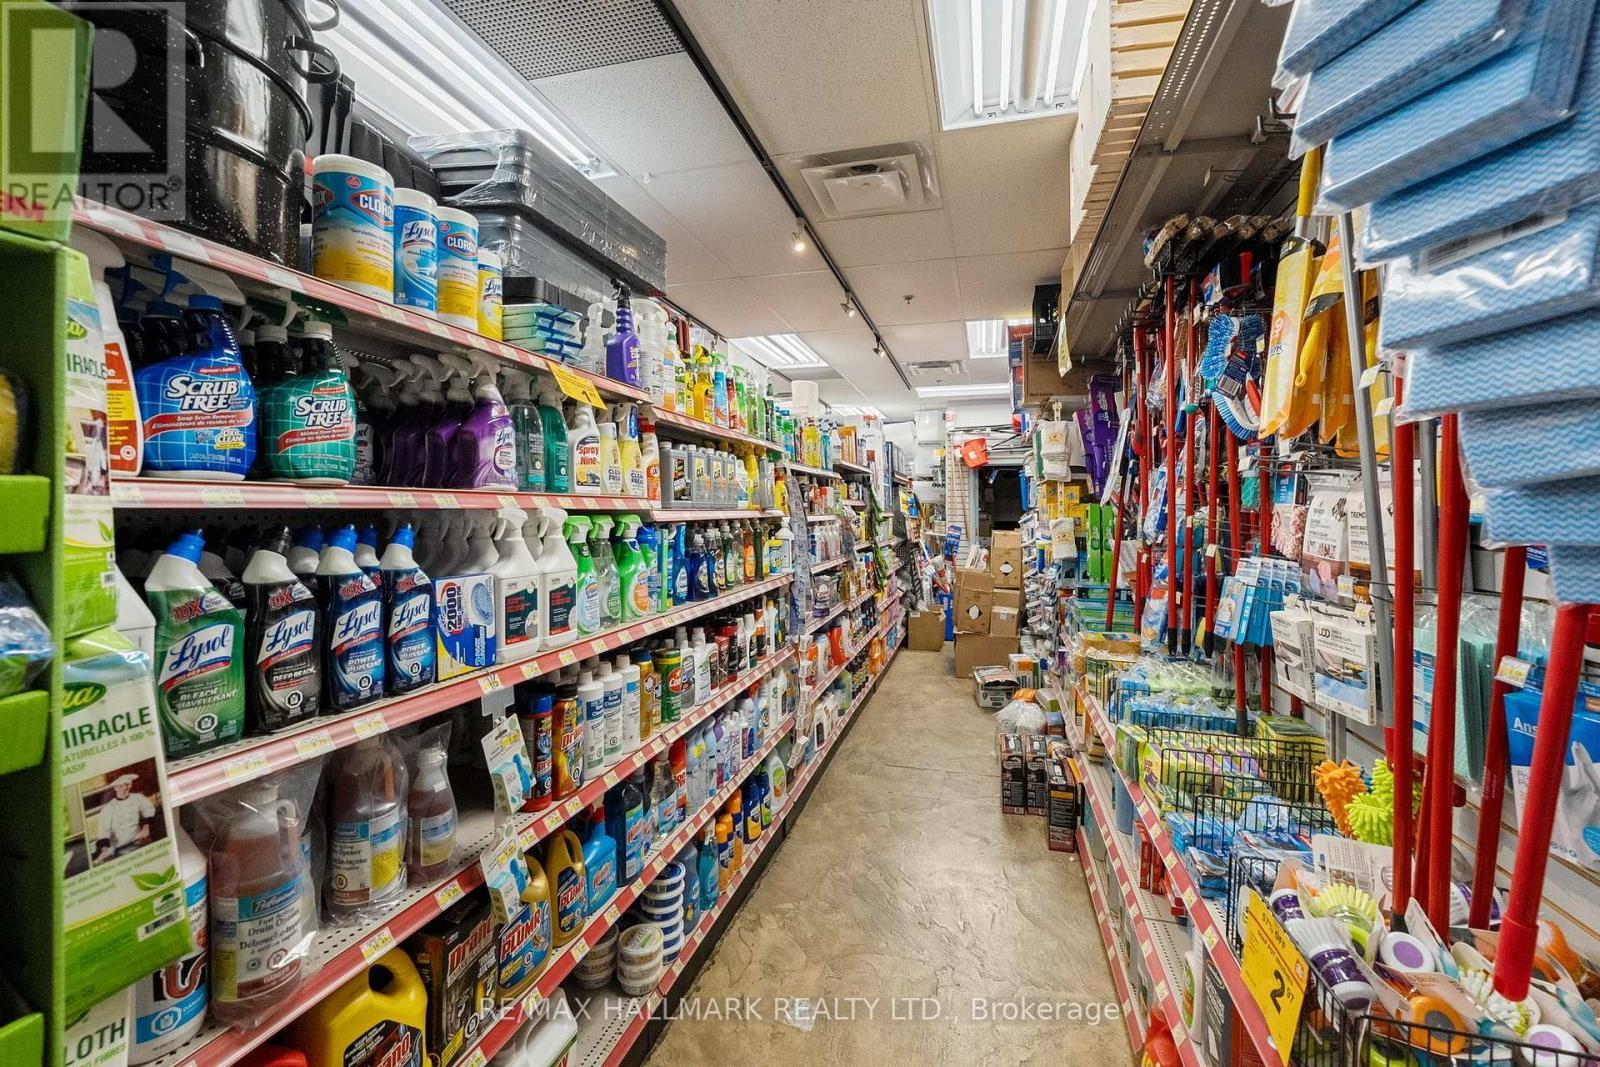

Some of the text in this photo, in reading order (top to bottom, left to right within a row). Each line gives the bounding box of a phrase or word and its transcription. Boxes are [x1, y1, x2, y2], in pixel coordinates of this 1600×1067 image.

[166, 374, 239, 399] SCRUB
[180, 394, 231, 413] FREE
[295, 396, 347, 417] SCRUB
[306, 412, 342, 427] FREE
[579, 445, 599, 455] Spray
[580, 457, 597, 465] Nine
[394, 597, 428, 628] Lysol
[447, 585, 458, 631] 2000
[266, 613, 312, 653] Lysol
[338, 606, 378, 639] Lysol
[169, 626, 230, 671] Lysol
[349, 654, 376, 665] POWER
[402, 643, 425, 653] POWER
[63, 707, 152, 749] IRACLE
[1270, 968, 1286, 1015] 2
